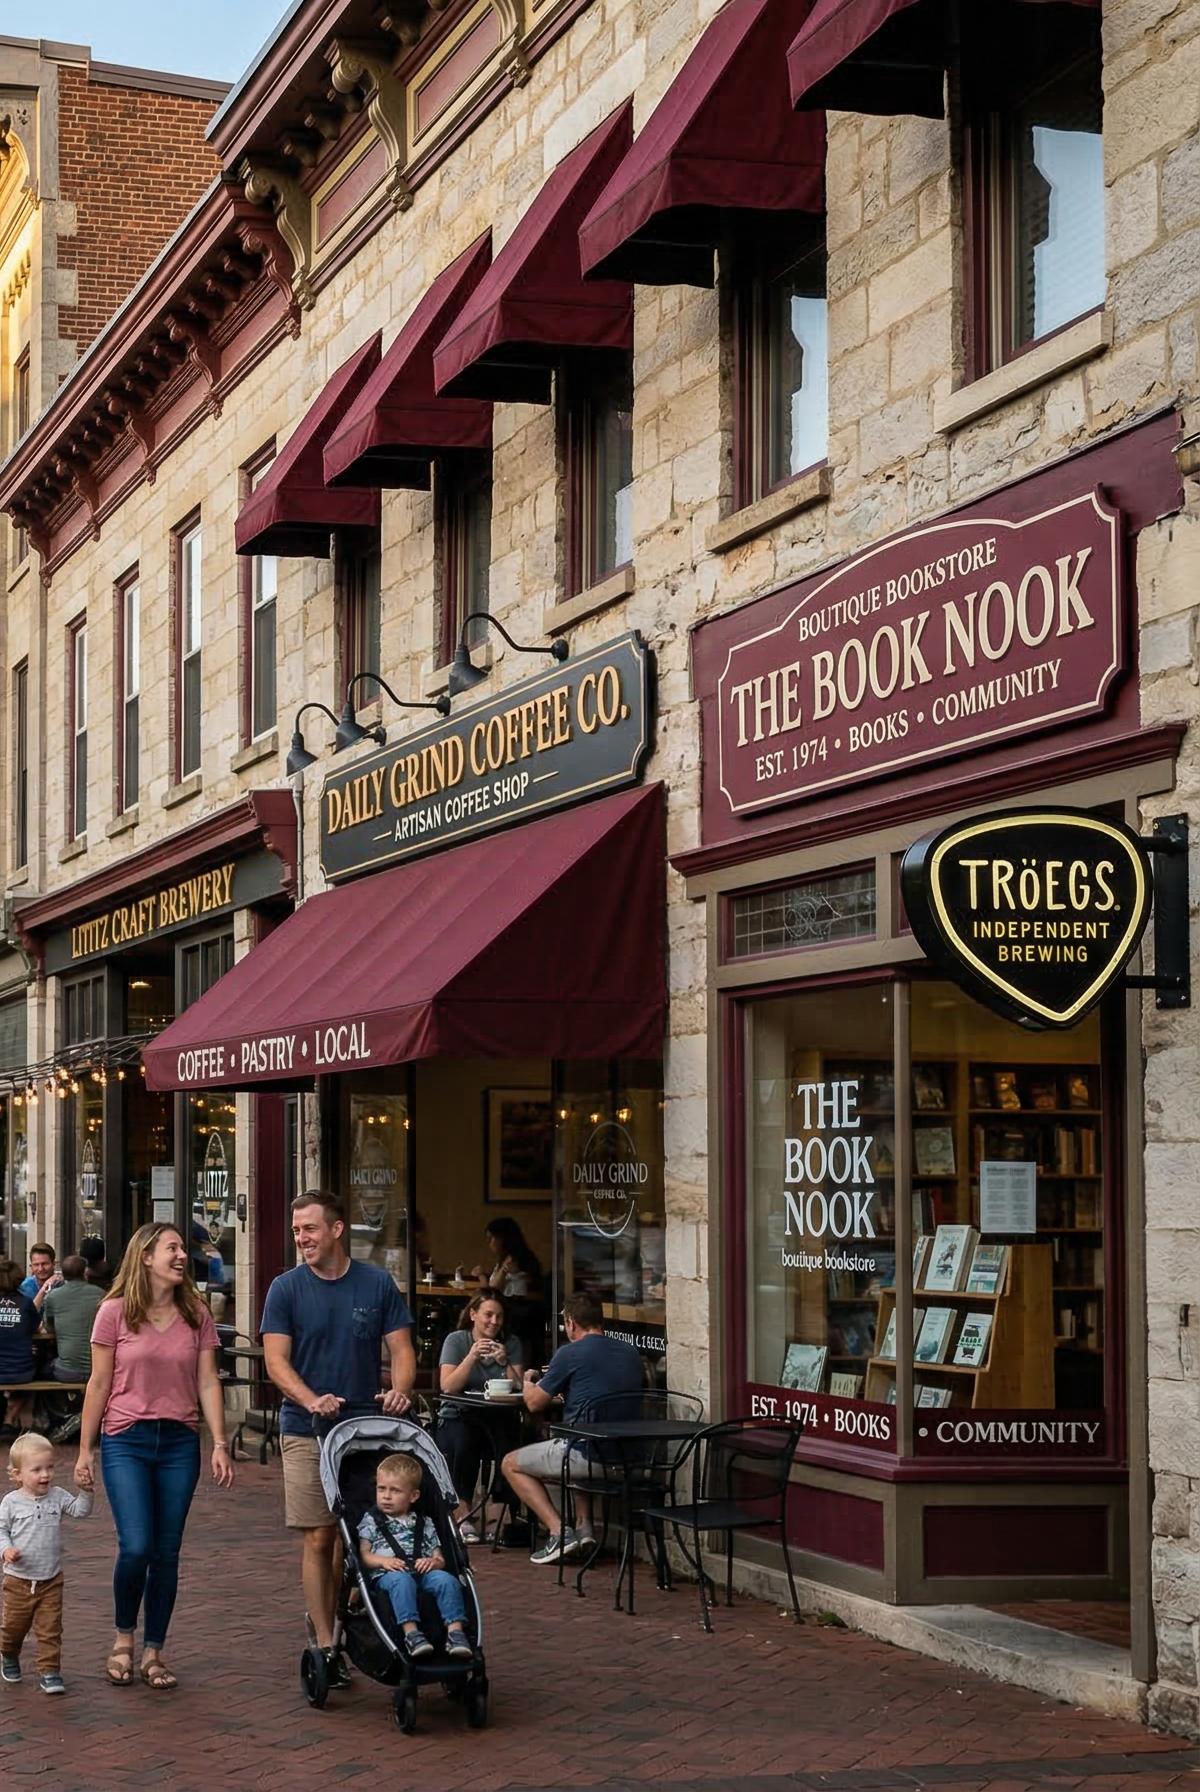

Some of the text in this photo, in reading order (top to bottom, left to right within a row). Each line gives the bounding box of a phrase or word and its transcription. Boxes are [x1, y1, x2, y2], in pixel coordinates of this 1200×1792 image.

[798, 538, 997, 642] BOUTIQUE BOOKSTORE
[731, 546, 1095, 748] THE BOOK NOOK
[755, 658, 1062, 782] EST. 1974 BOOKS COMMUNITY
[326, 665, 630, 834] DAILY GRIND COFFEE CO.
[394, 772, 529, 842] ARTISAN COFFEE SHOP
[111, 895, 157, 945] CRAFT
[159, 863, 235, 929] BREWERY
[958, 858, 1116, 911] TRÖEGS
[973, 921, 1110, 939] INDEPENDENT
[998, 945, 1088, 963] BREWING
[177, 1022, 371, 1082] COFFEE PASTRY LOCAL
[797, 1080, 861, 1129] THE
[573, 1162, 648, 1184] DAILY GRIND
[784, 1135, 875, 1185] BOOK
[783, 1191, 876, 1238] NOOK
[785, 1400, 819, 1428] 1974
[834, 1408, 891, 1441] BOOKS
[936, 1421, 1101, 1444] COMMUNITY
